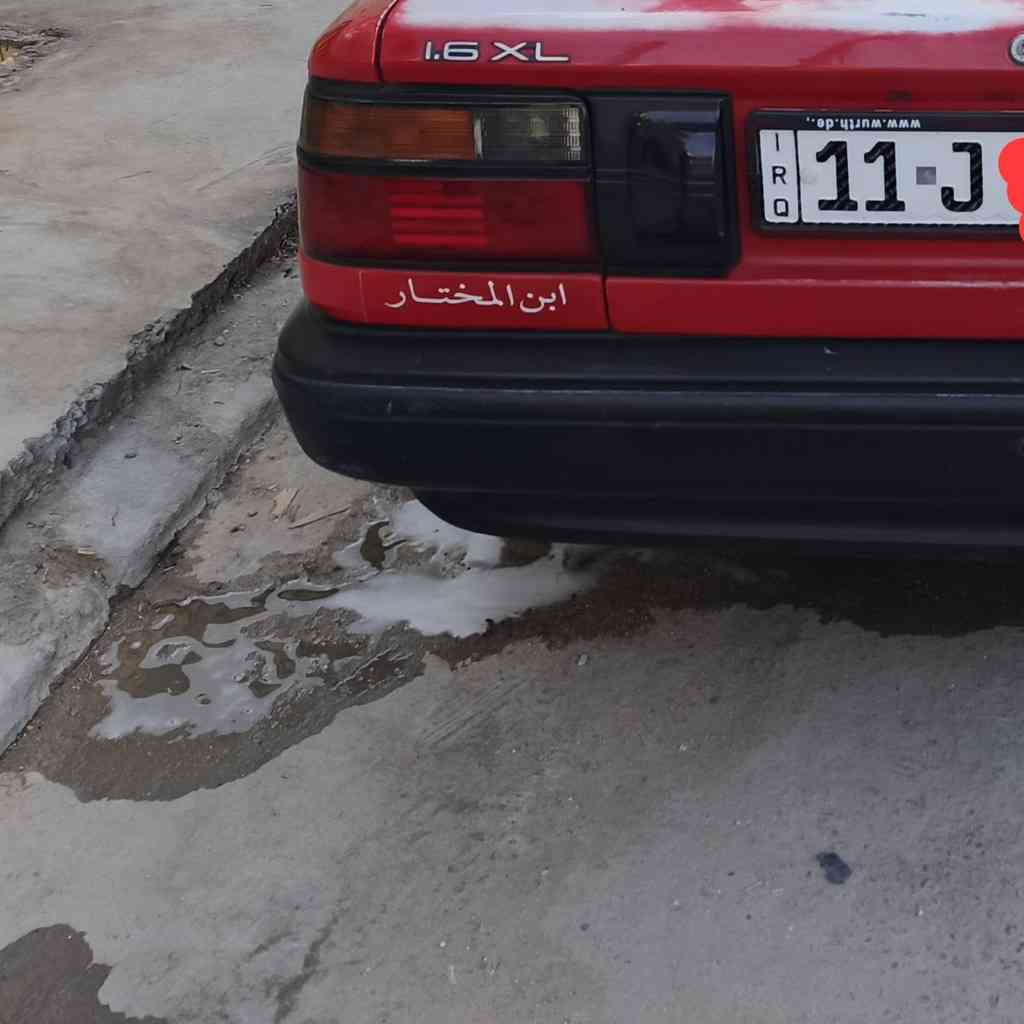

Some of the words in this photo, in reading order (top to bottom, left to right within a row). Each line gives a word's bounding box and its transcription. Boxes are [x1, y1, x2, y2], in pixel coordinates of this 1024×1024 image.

[425, 40, 479, 62] 1.6
[491, 41, 570, 62] XL
[815, 140, 906, 212] 11
[940, 141, 984, 213] J
[518, 282, 567, 314] ابن
